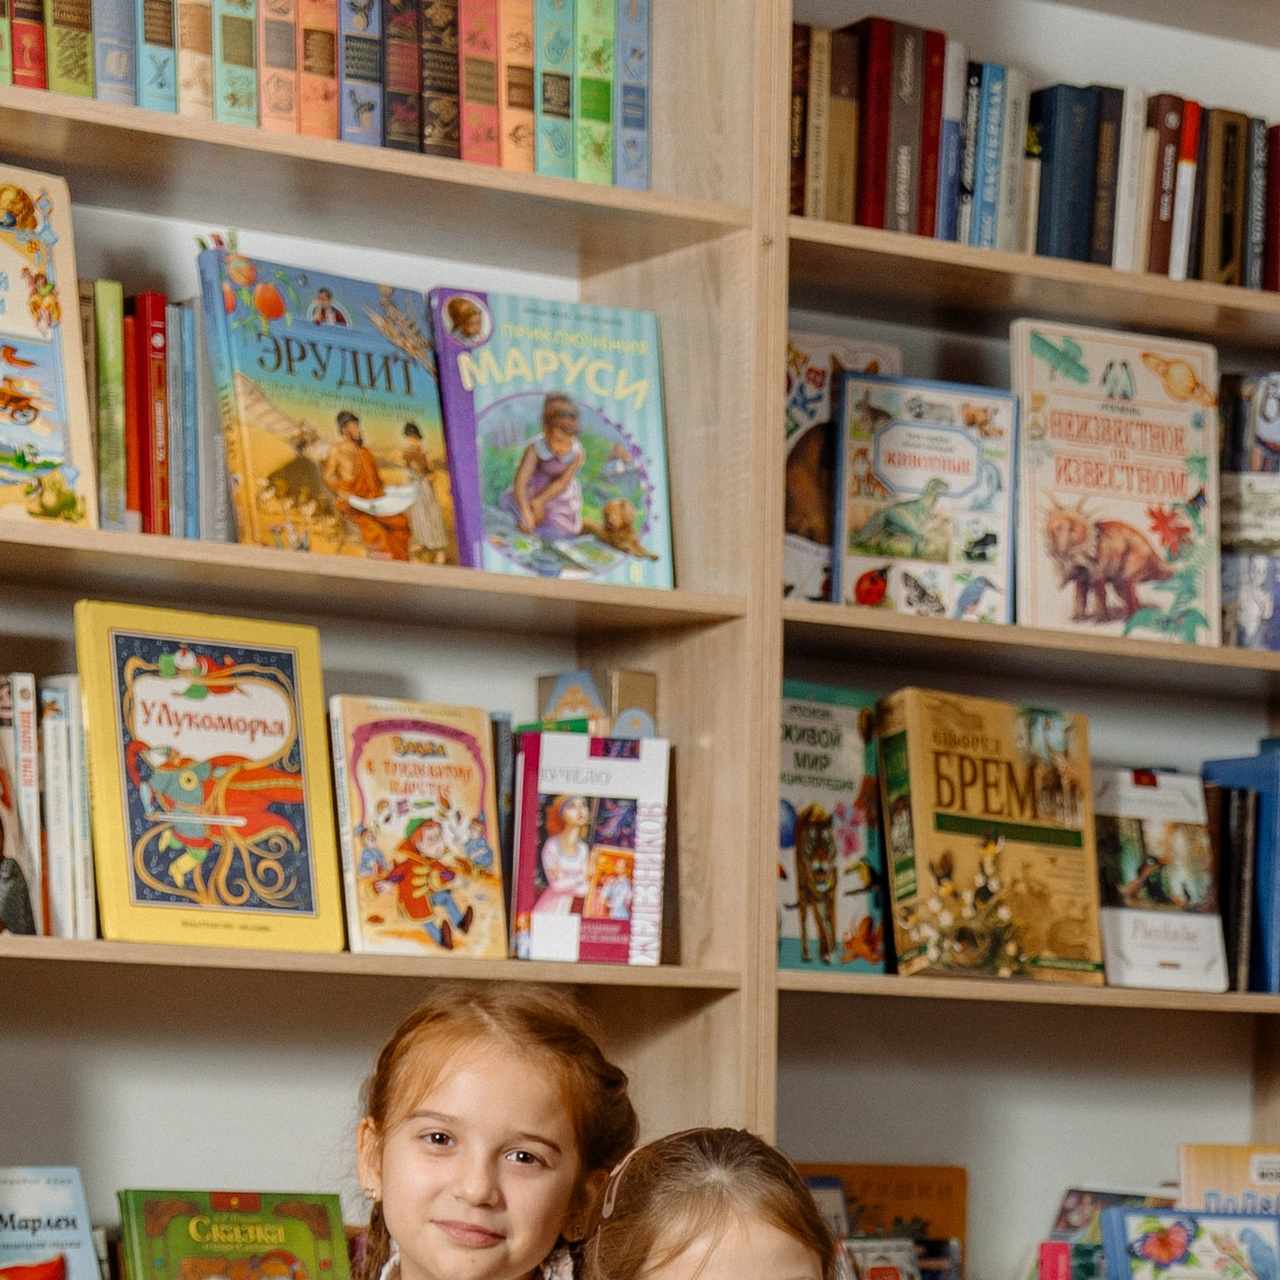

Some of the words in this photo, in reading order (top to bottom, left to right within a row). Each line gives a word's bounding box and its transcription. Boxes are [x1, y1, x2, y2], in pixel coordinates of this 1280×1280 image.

[502, 322, 647, 356] ПРИКЛЮЧЕНИЯ
[257, 332, 420, 397] ЭРУДИТ
[457, 347, 649, 410] МАРУСИ
[1050, 411, 1186, 456] НЕИЗВЕСТНОЕ
[1054, 457, 1187, 496] ИЗВЕСТНОМ
[793, 751, 832, 771] МИР
[933, 751, 1040, 820] БРЕМ
[188, 1215, 286, 1244] Сказки
